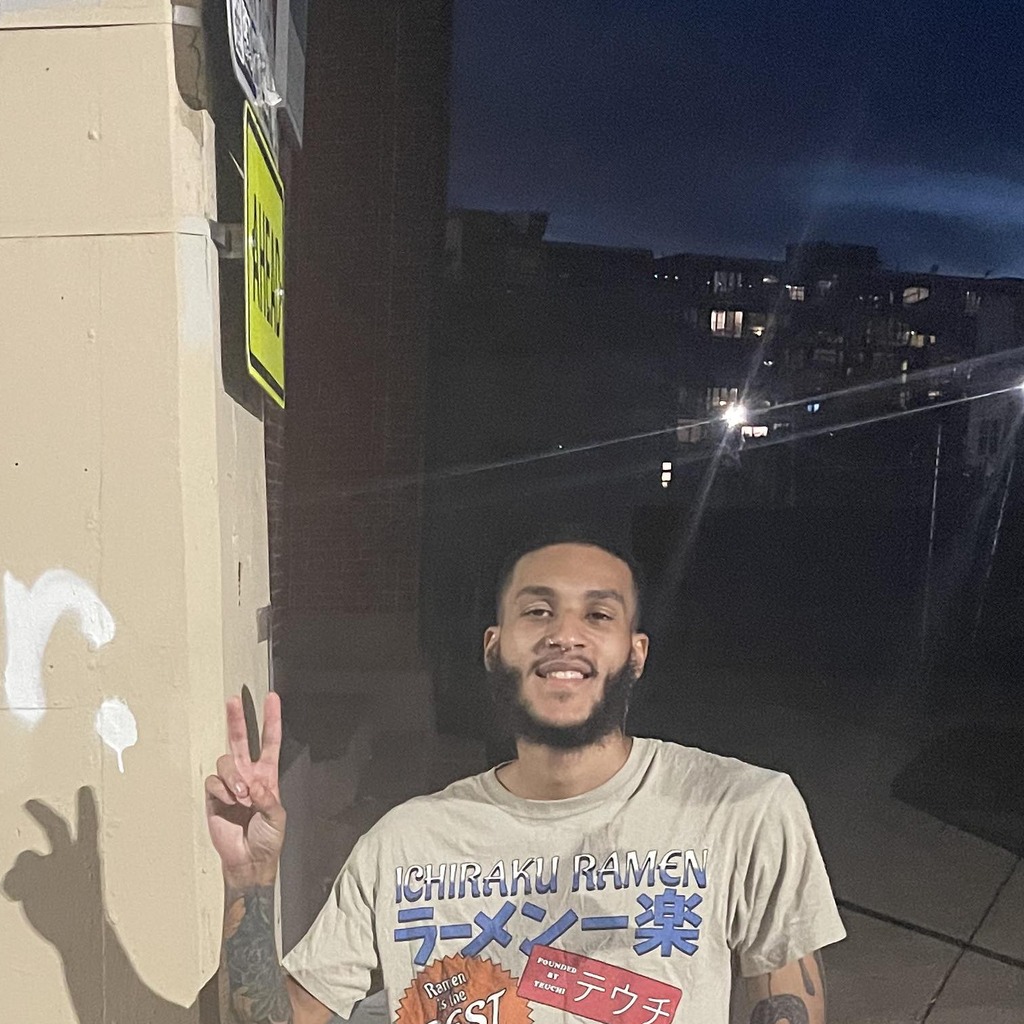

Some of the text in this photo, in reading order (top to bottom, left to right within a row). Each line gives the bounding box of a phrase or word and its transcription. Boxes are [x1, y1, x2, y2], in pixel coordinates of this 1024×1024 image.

[251, 193, 282, 338] AHEAD
[395, 848, 709, 904] ICHIRAKU RAMEN
[537, 957, 577, 974] FOUNDED
[423, 972, 467, 999] Ramen
[533, 980, 566, 995] TEUCHI
